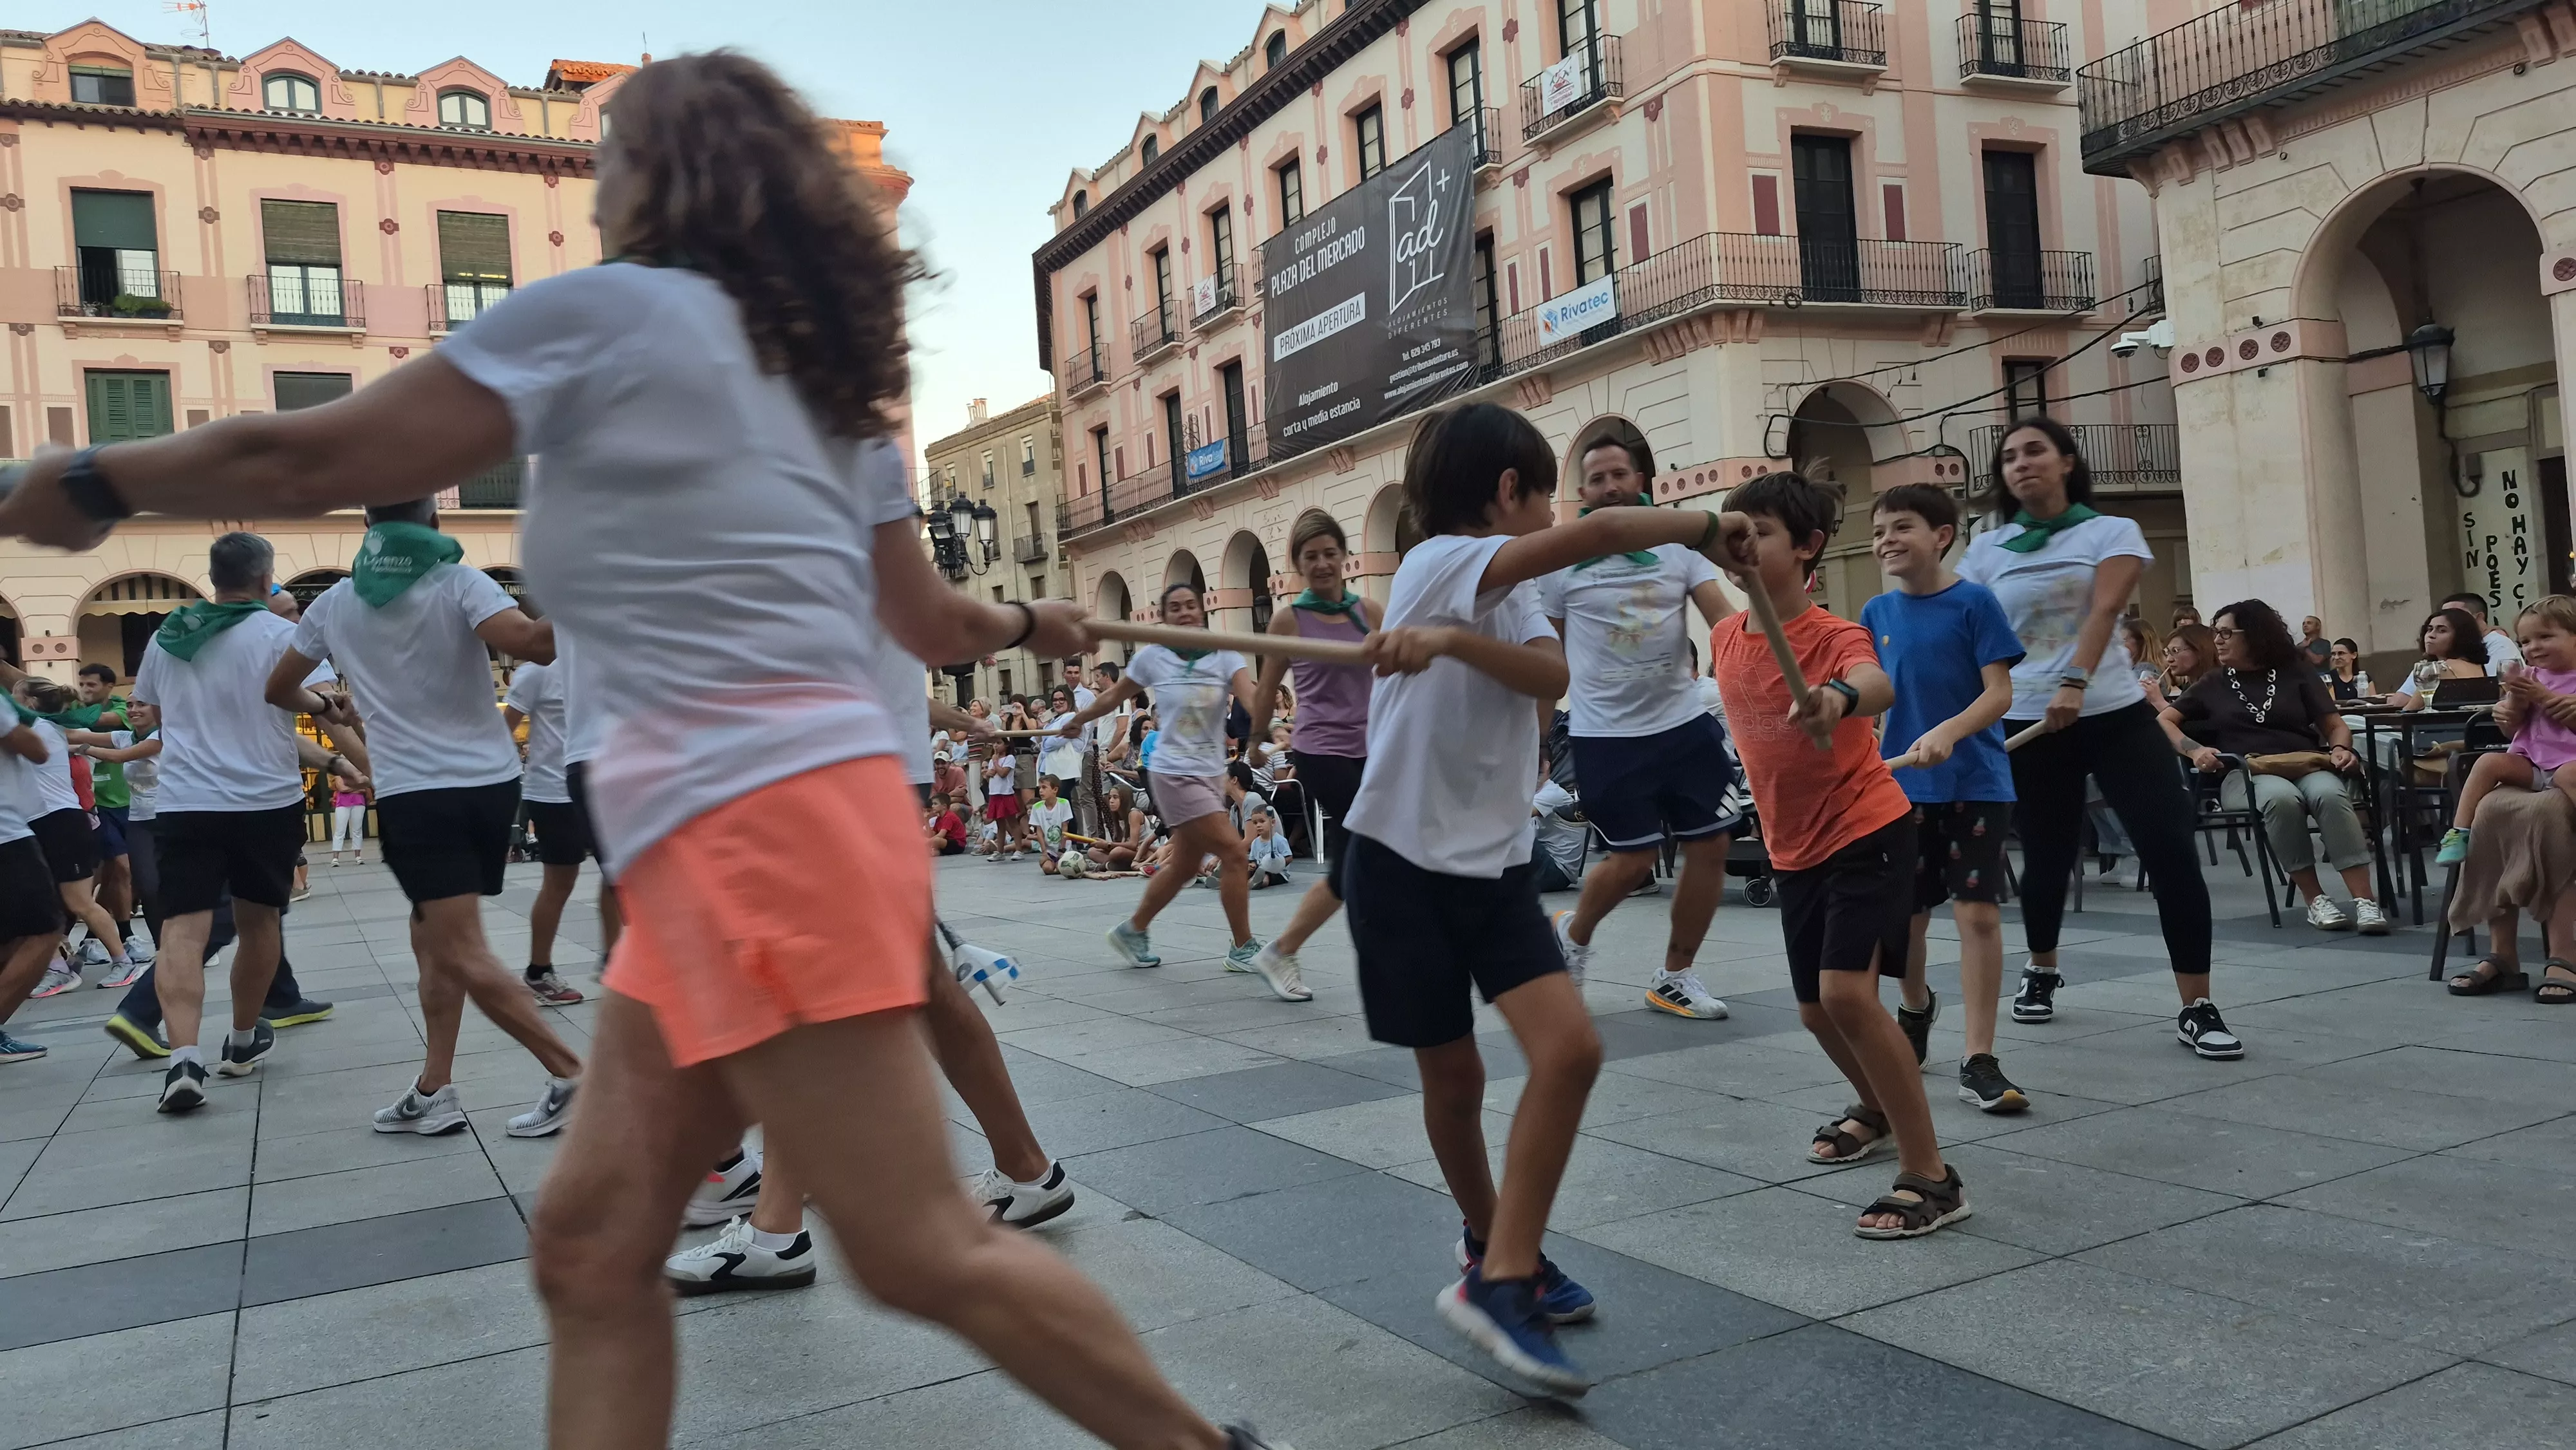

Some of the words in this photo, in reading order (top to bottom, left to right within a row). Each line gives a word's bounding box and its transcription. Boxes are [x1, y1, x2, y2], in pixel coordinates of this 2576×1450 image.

[1295, 216, 1336, 254] COMPLEJO
[1271, 264, 1298, 299] PLAZA
[1300, 254, 1316, 283] DEL
[1318, 225, 1365, 273] MERCADO
[1388, 297, 1448, 328] ALOJAMIENTOS
[1388, 308, 1448, 339] DIFERENTES
[1561, 292, 1608, 321] Rivatec
[1280, 323, 1315, 354] PRÓXIMA
[1318, 300, 1360, 336] APERTURA
[1298, 381, 1338, 407] Alojamiento
[1283, 420, 1302, 437] corta
[1302, 420, 1308, 431] y
[1308, 410, 1329, 428] media
[1329, 397, 1360, 419] estancia
[1199, 452, 1217, 466] Riva
[2463, 512, 2479, 569] SIN
[2502, 469, 2519, 509] NO
[2512, 514, 2528, 575] HAY
